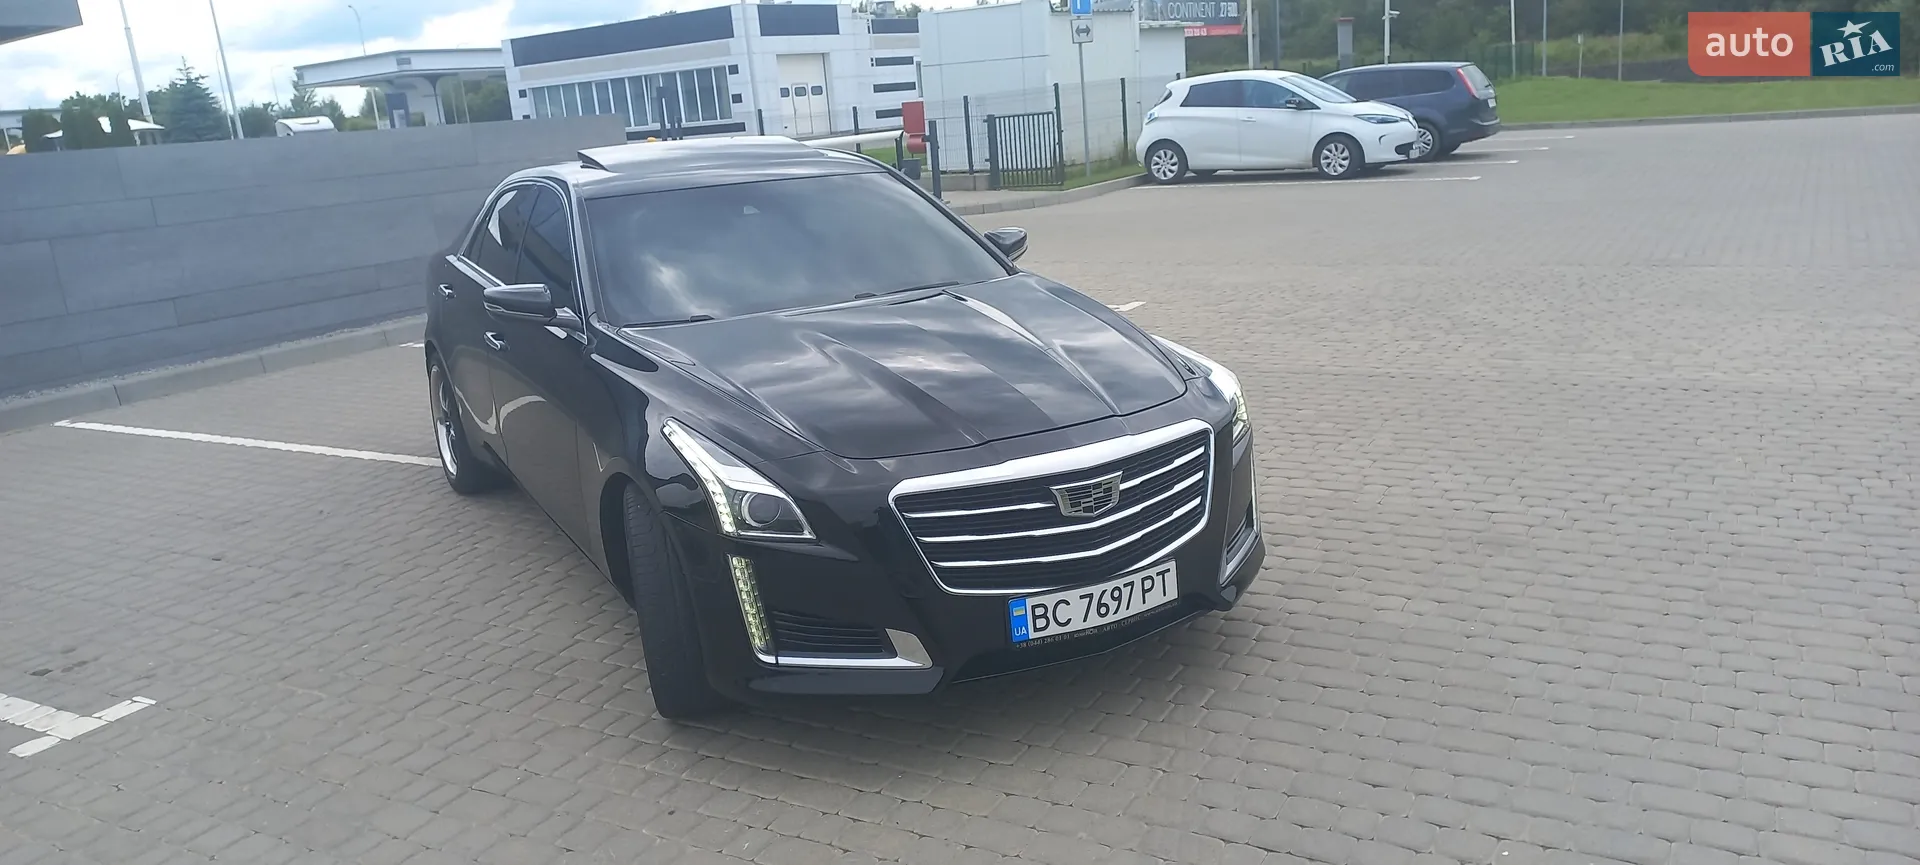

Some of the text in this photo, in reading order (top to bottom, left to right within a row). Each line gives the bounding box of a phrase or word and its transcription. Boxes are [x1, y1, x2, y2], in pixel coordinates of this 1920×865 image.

[1167, 2, 1216, 19] CONTINENT
[1030, 599, 1072, 633] BC
[1079, 580, 1135, 623] 7697
[1141, 568, 1171, 605] PT
[1014, 626, 1027, 636] UA
